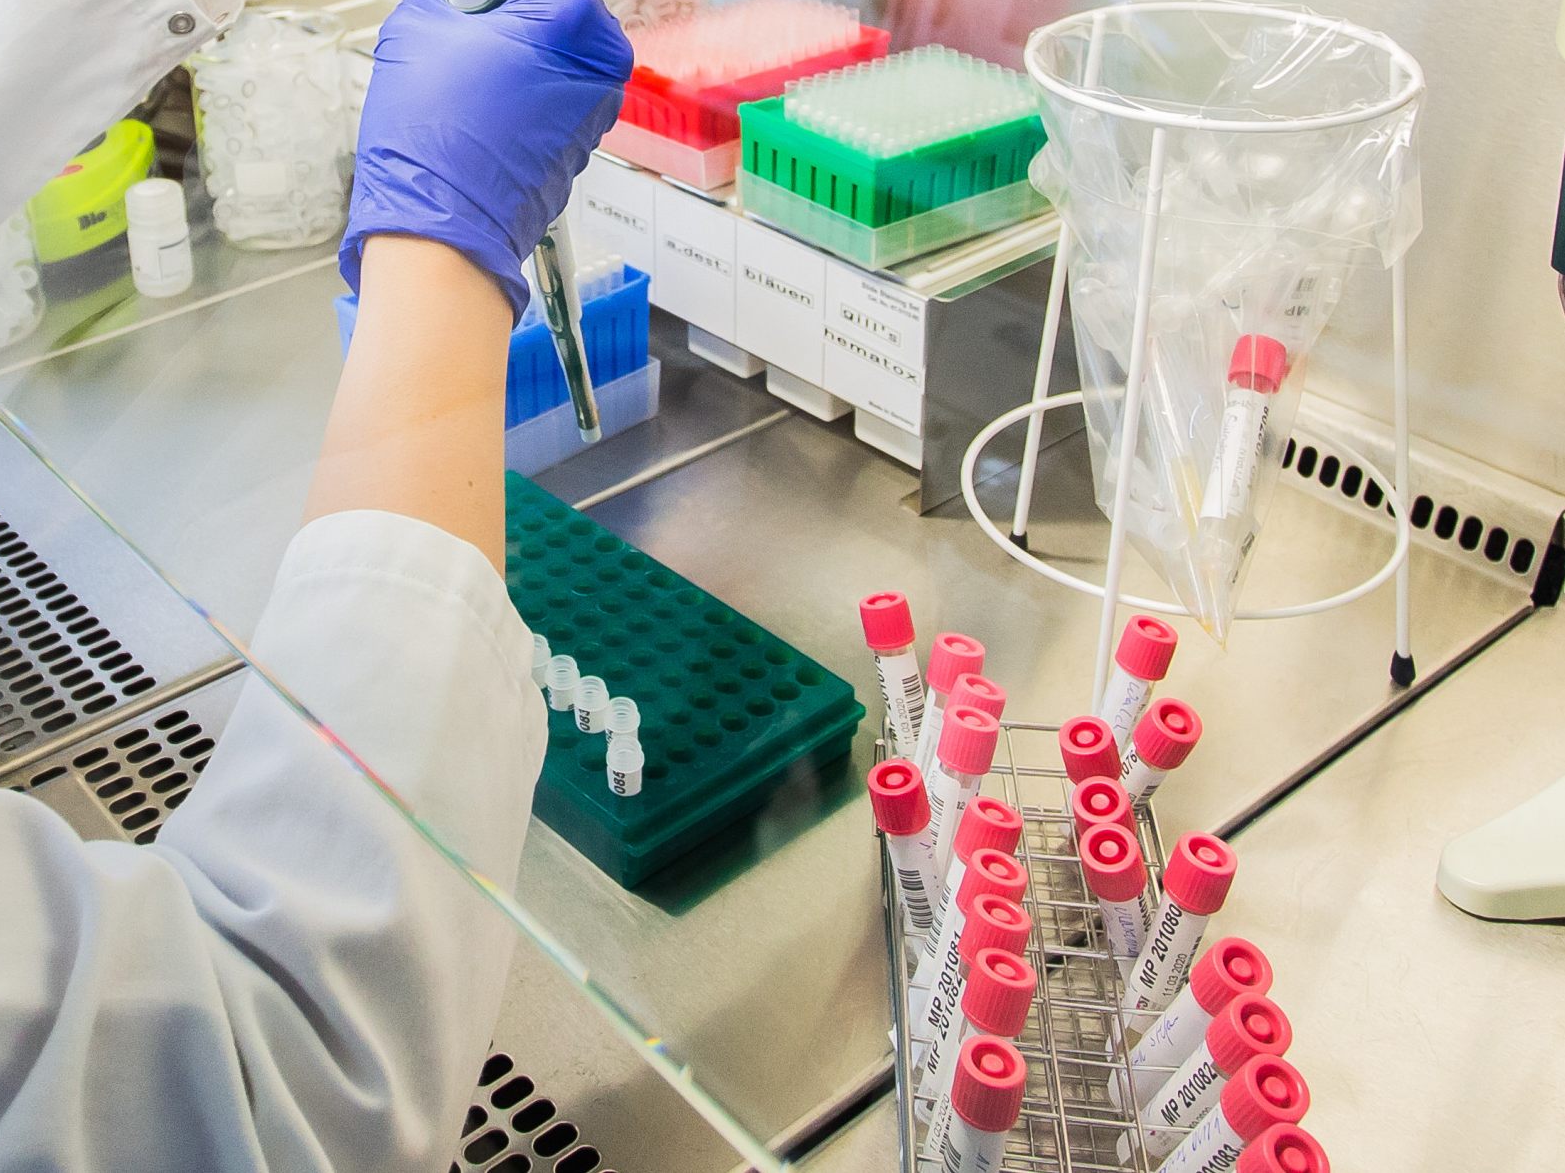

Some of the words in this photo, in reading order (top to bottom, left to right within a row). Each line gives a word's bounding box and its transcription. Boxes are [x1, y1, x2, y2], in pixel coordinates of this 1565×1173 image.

[77, 210, 107, 230] Bio
[824, 327, 918, 383] hematox
[1139, 959, 1158, 989] MP
[1151, 903, 1183, 963] 201080
[927, 995, 944, 1028] MP
[937, 930, 961, 994] 201081
[926, 1040, 942, 1075] MP
[1160, 1098, 1181, 1126] MP
[1177, 1061, 1218, 1109] 201082
